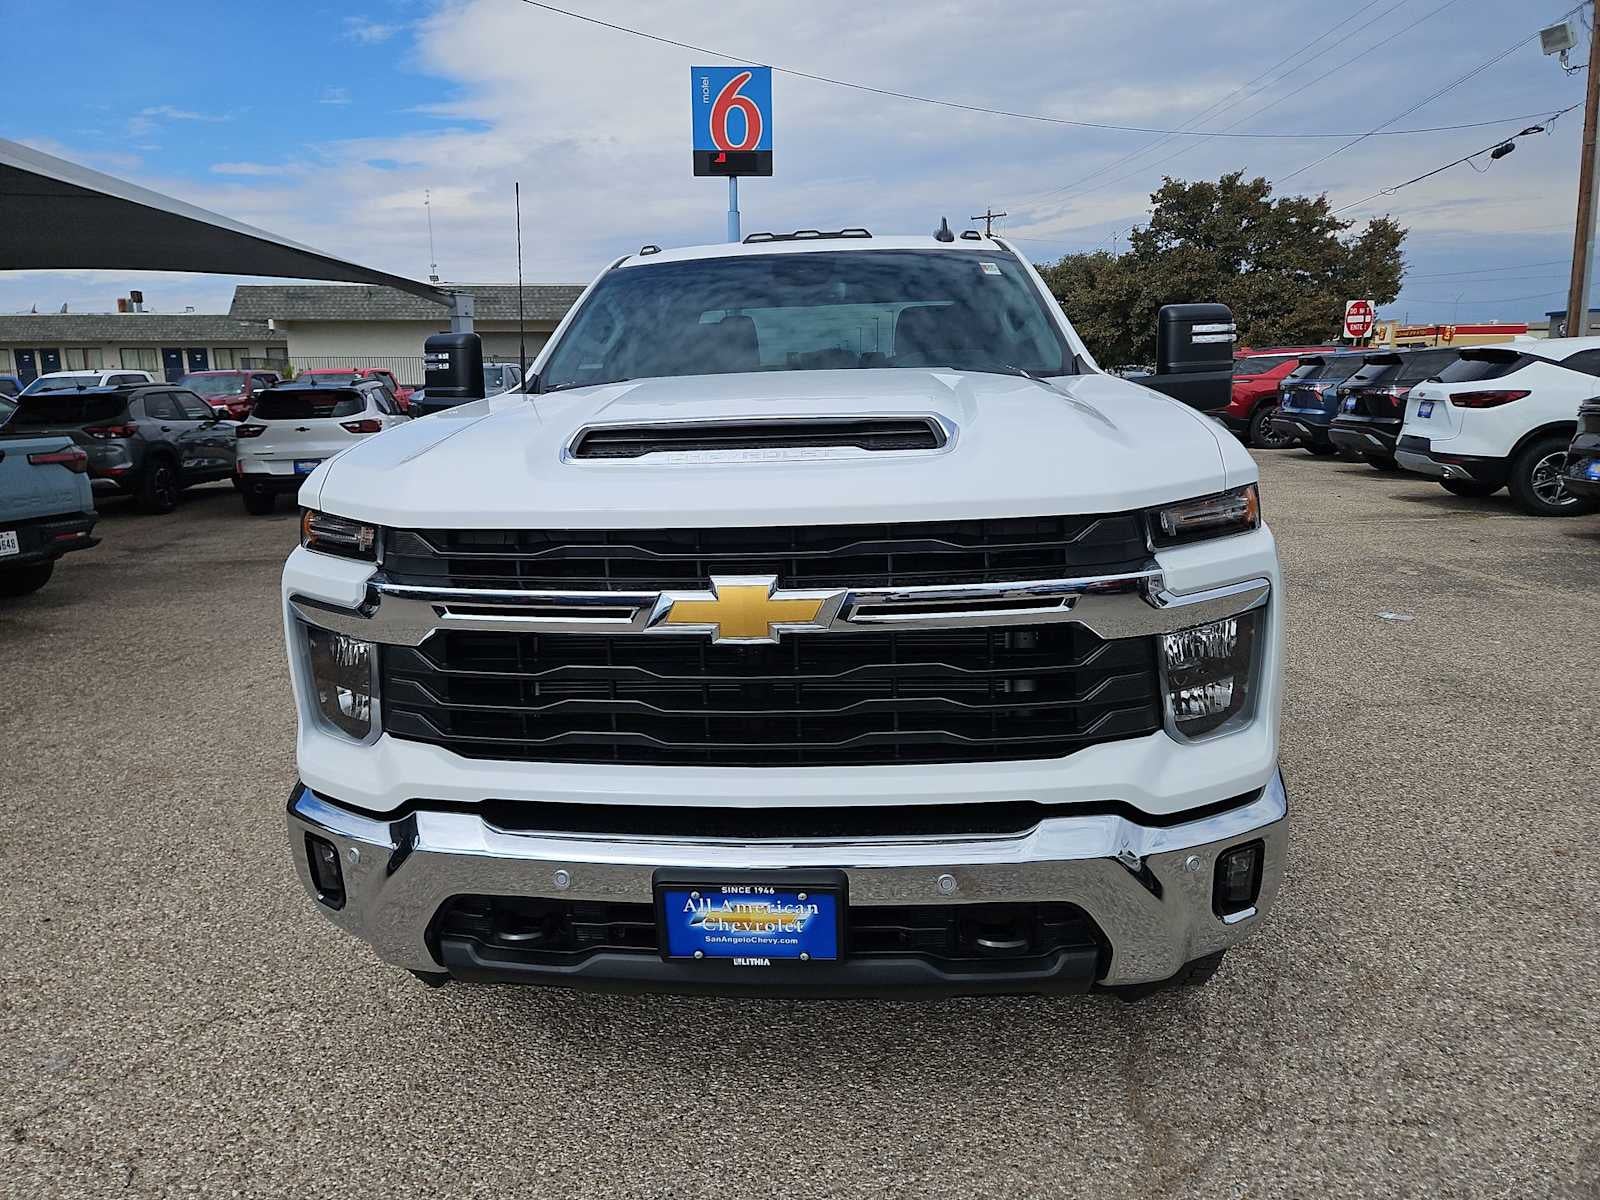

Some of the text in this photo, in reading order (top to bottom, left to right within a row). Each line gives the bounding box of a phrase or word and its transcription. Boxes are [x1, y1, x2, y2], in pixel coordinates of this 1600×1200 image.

[701, 76, 710, 104] motel
[709, 71, 763, 151] 6
[721, 886, 775, 895] SINCE 1946
[683, 898, 820, 915] All American
[702, 917, 804, 933] Chevrolet
[705, 935, 798, 945] SanAngeloChevy.com
[742, 957, 770, 966] LITHIA
